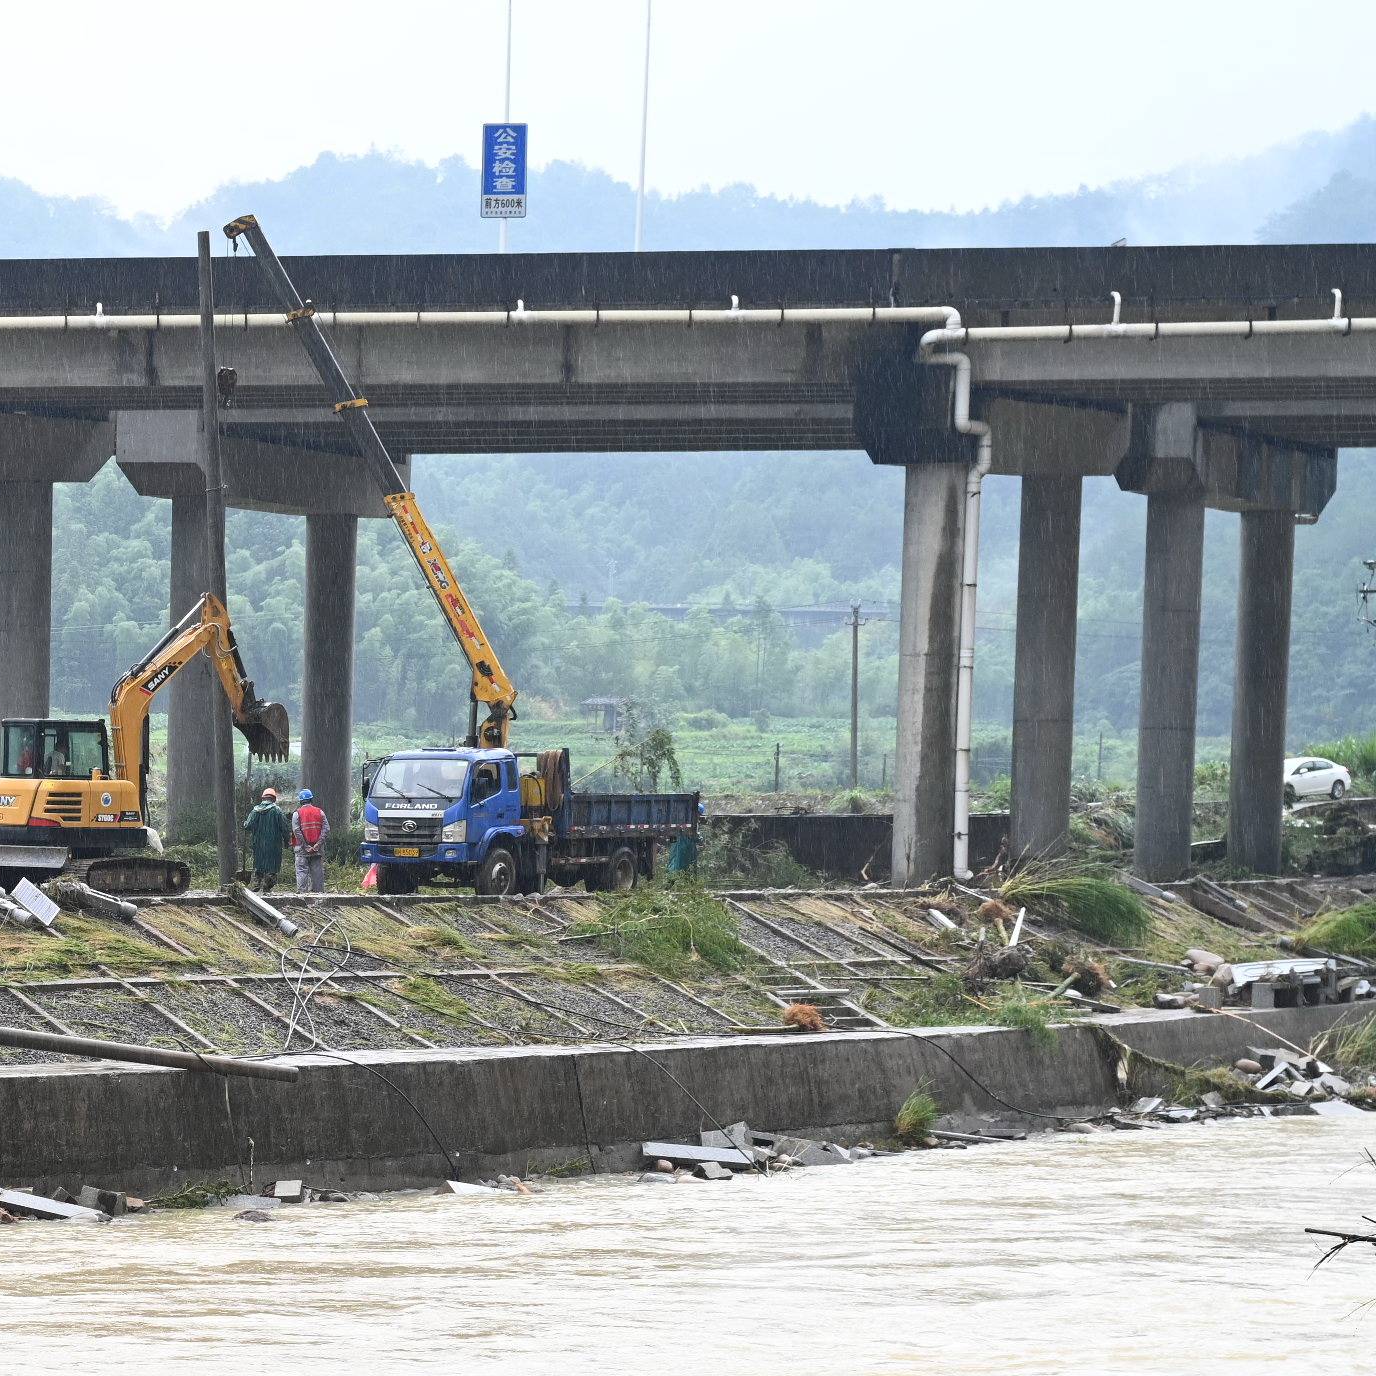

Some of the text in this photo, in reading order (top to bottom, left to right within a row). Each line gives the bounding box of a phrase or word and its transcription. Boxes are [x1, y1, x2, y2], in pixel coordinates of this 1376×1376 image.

[493, 127, 517, 192] 公安检查
[484, 197, 523, 209] 前方600米
[148, 667, 169, 691] SANY
